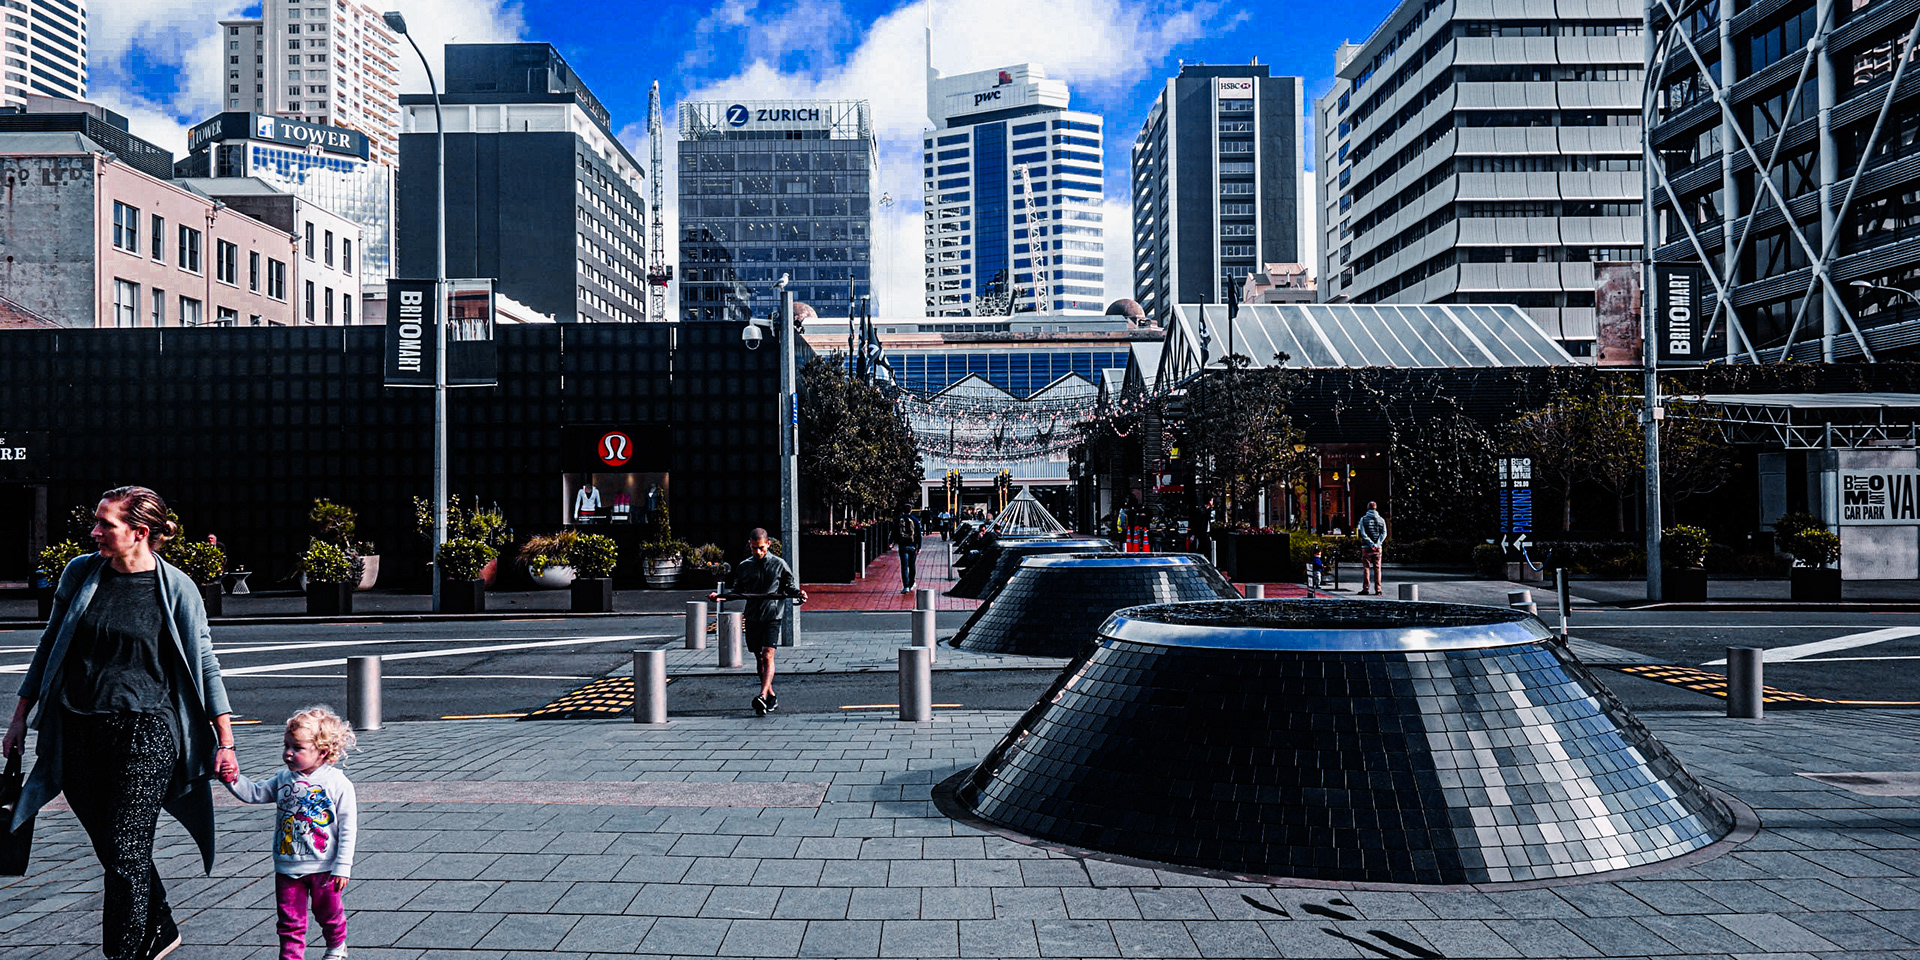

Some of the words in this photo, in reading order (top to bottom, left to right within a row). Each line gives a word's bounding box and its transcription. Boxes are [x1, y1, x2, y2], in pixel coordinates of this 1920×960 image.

[757, 109, 819, 121] ZURICH
[974, 91, 1001, 106] pwc
[195, 120, 222, 144] TOWER
[280, 123, 351, 148] TOWER
[1669, 274, 1691, 354] BRITOMART
[398, 291, 422, 372] BRITOMART
[1499, 489, 1509, 533] PARKING
[1512, 489, 1532, 533] PARKING
[1844, 506, 1861, 519] CAR
[1863, 506, 1885, 519] PARK
[1887, 475, 1920, 519] VA
